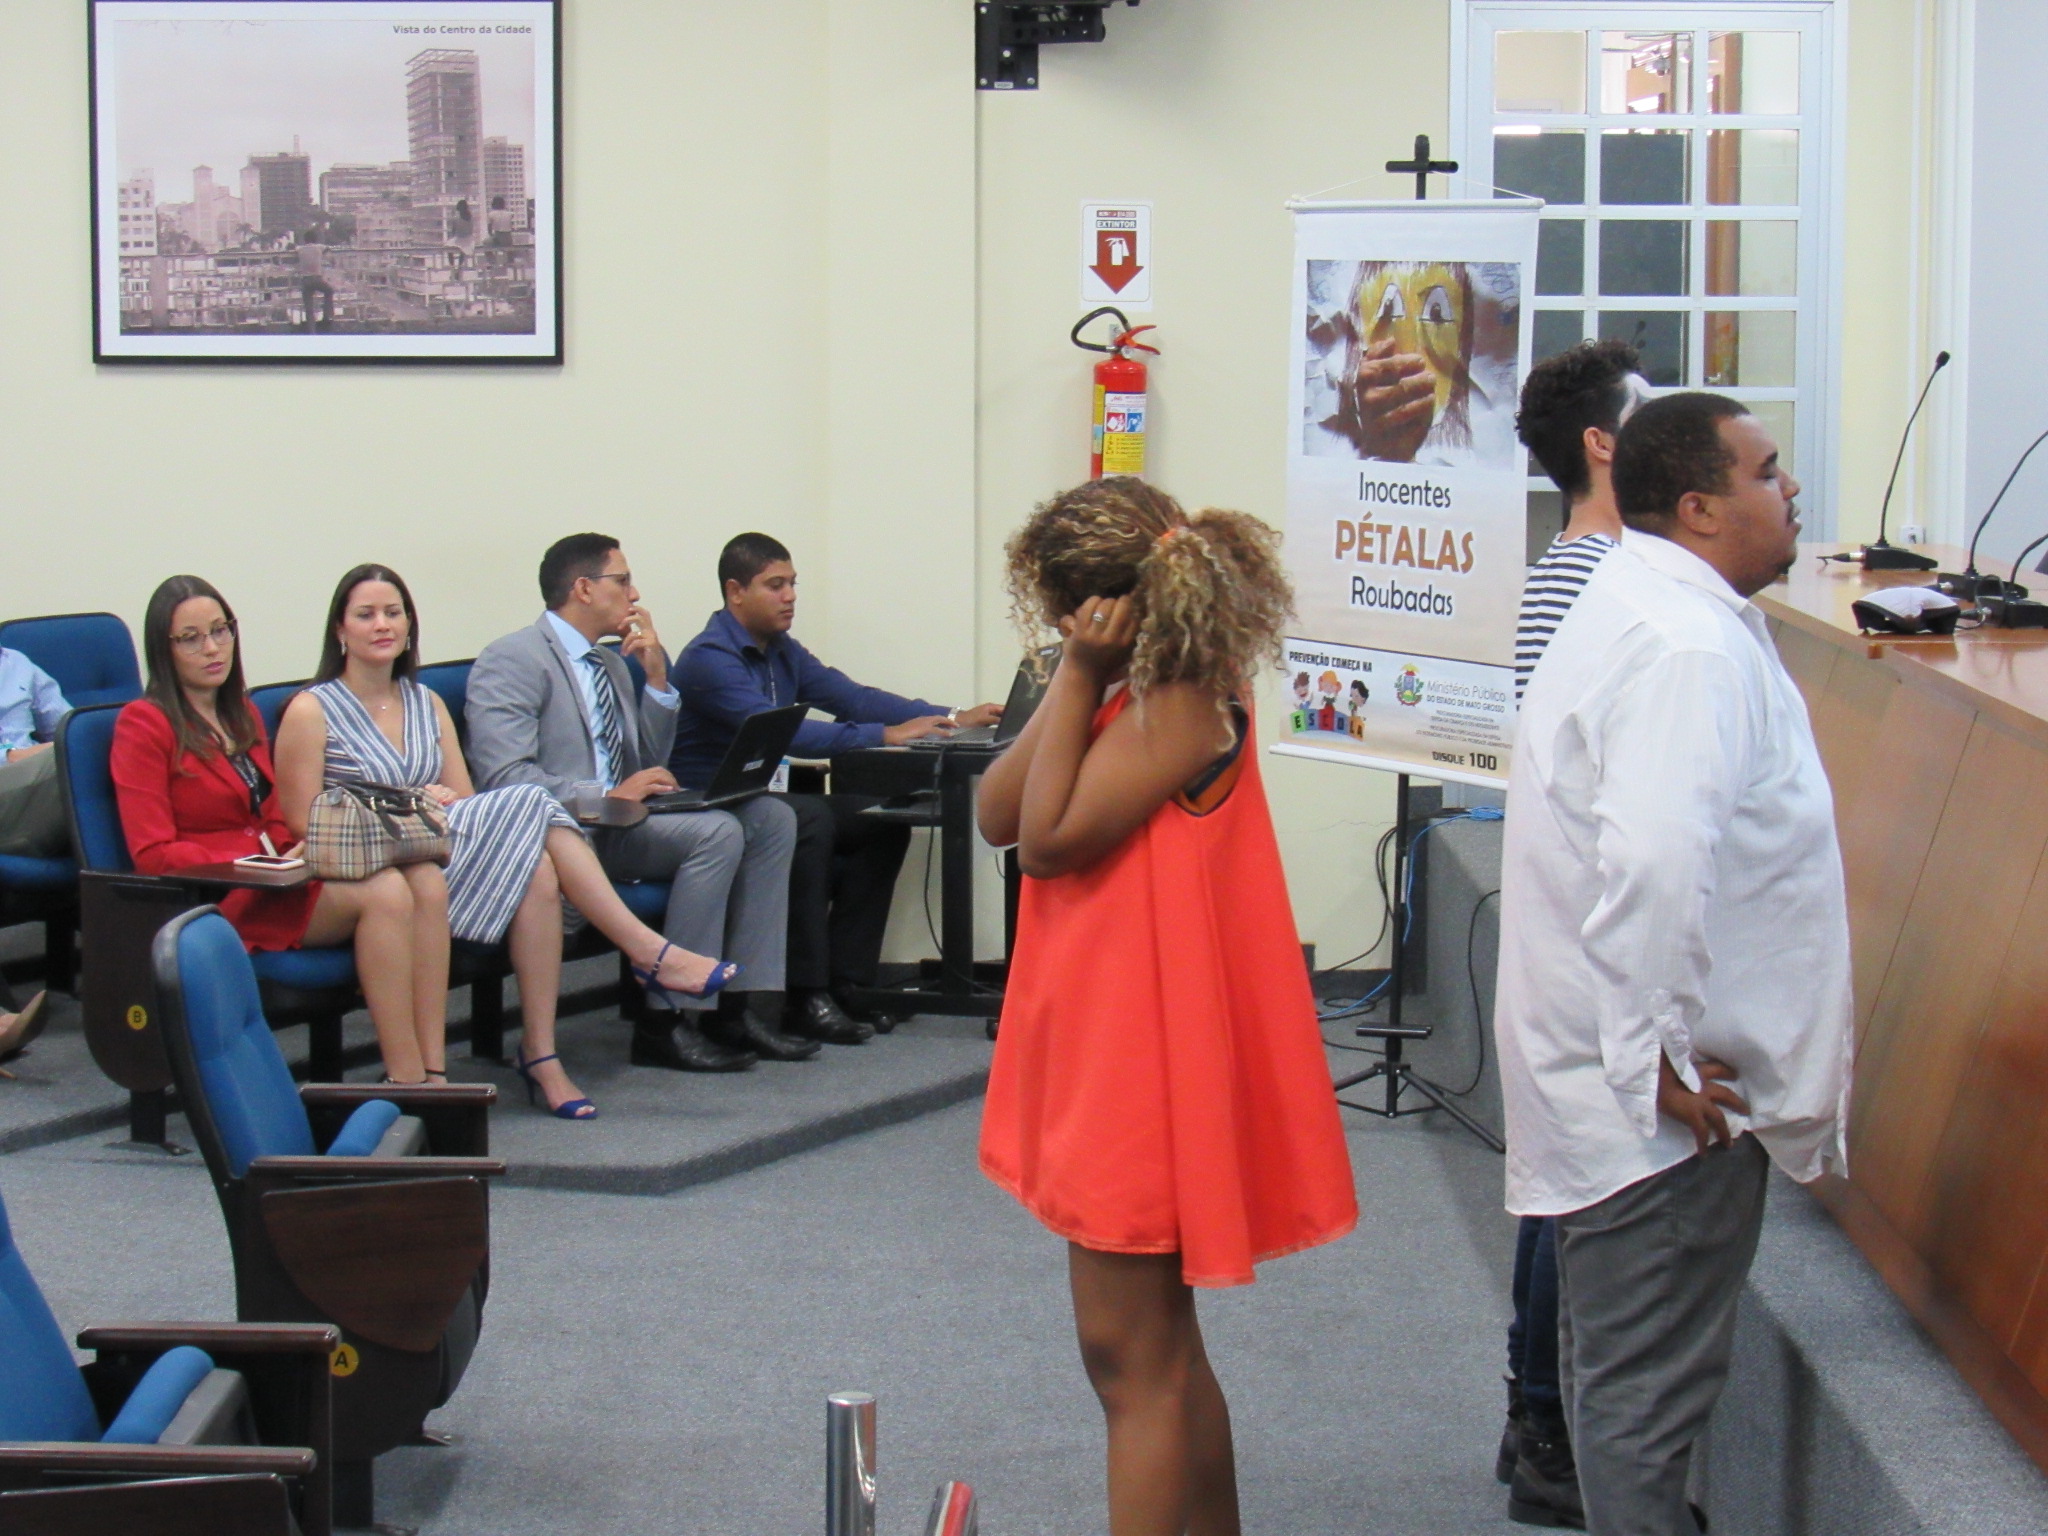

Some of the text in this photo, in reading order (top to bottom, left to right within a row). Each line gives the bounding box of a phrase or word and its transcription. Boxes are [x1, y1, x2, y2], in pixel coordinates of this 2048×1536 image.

[392, 25, 532, 34] Vista do Centro da Cidade
[1097, 220, 1136, 228] EXTINTOR
[1359, 472, 1452, 508] Inocentes
[1335, 511, 1474, 574] PÉTALAS
[1351, 575, 1453, 616] Roubadas
[1331, 657, 1360, 671] COMEÇA
[1362, 661, 1373, 672] NA
[1427, 680, 1506, 702] Ministério Público
[1426, 694, 1506, 714] DO ESTADO DE MATO GROSSO
[1294, 712, 1363, 738] ESCOLA
[1469, 752, 1497, 771] 100
[133, 1010, 142, 1023] B
[334, 1350, 348, 1368] A
